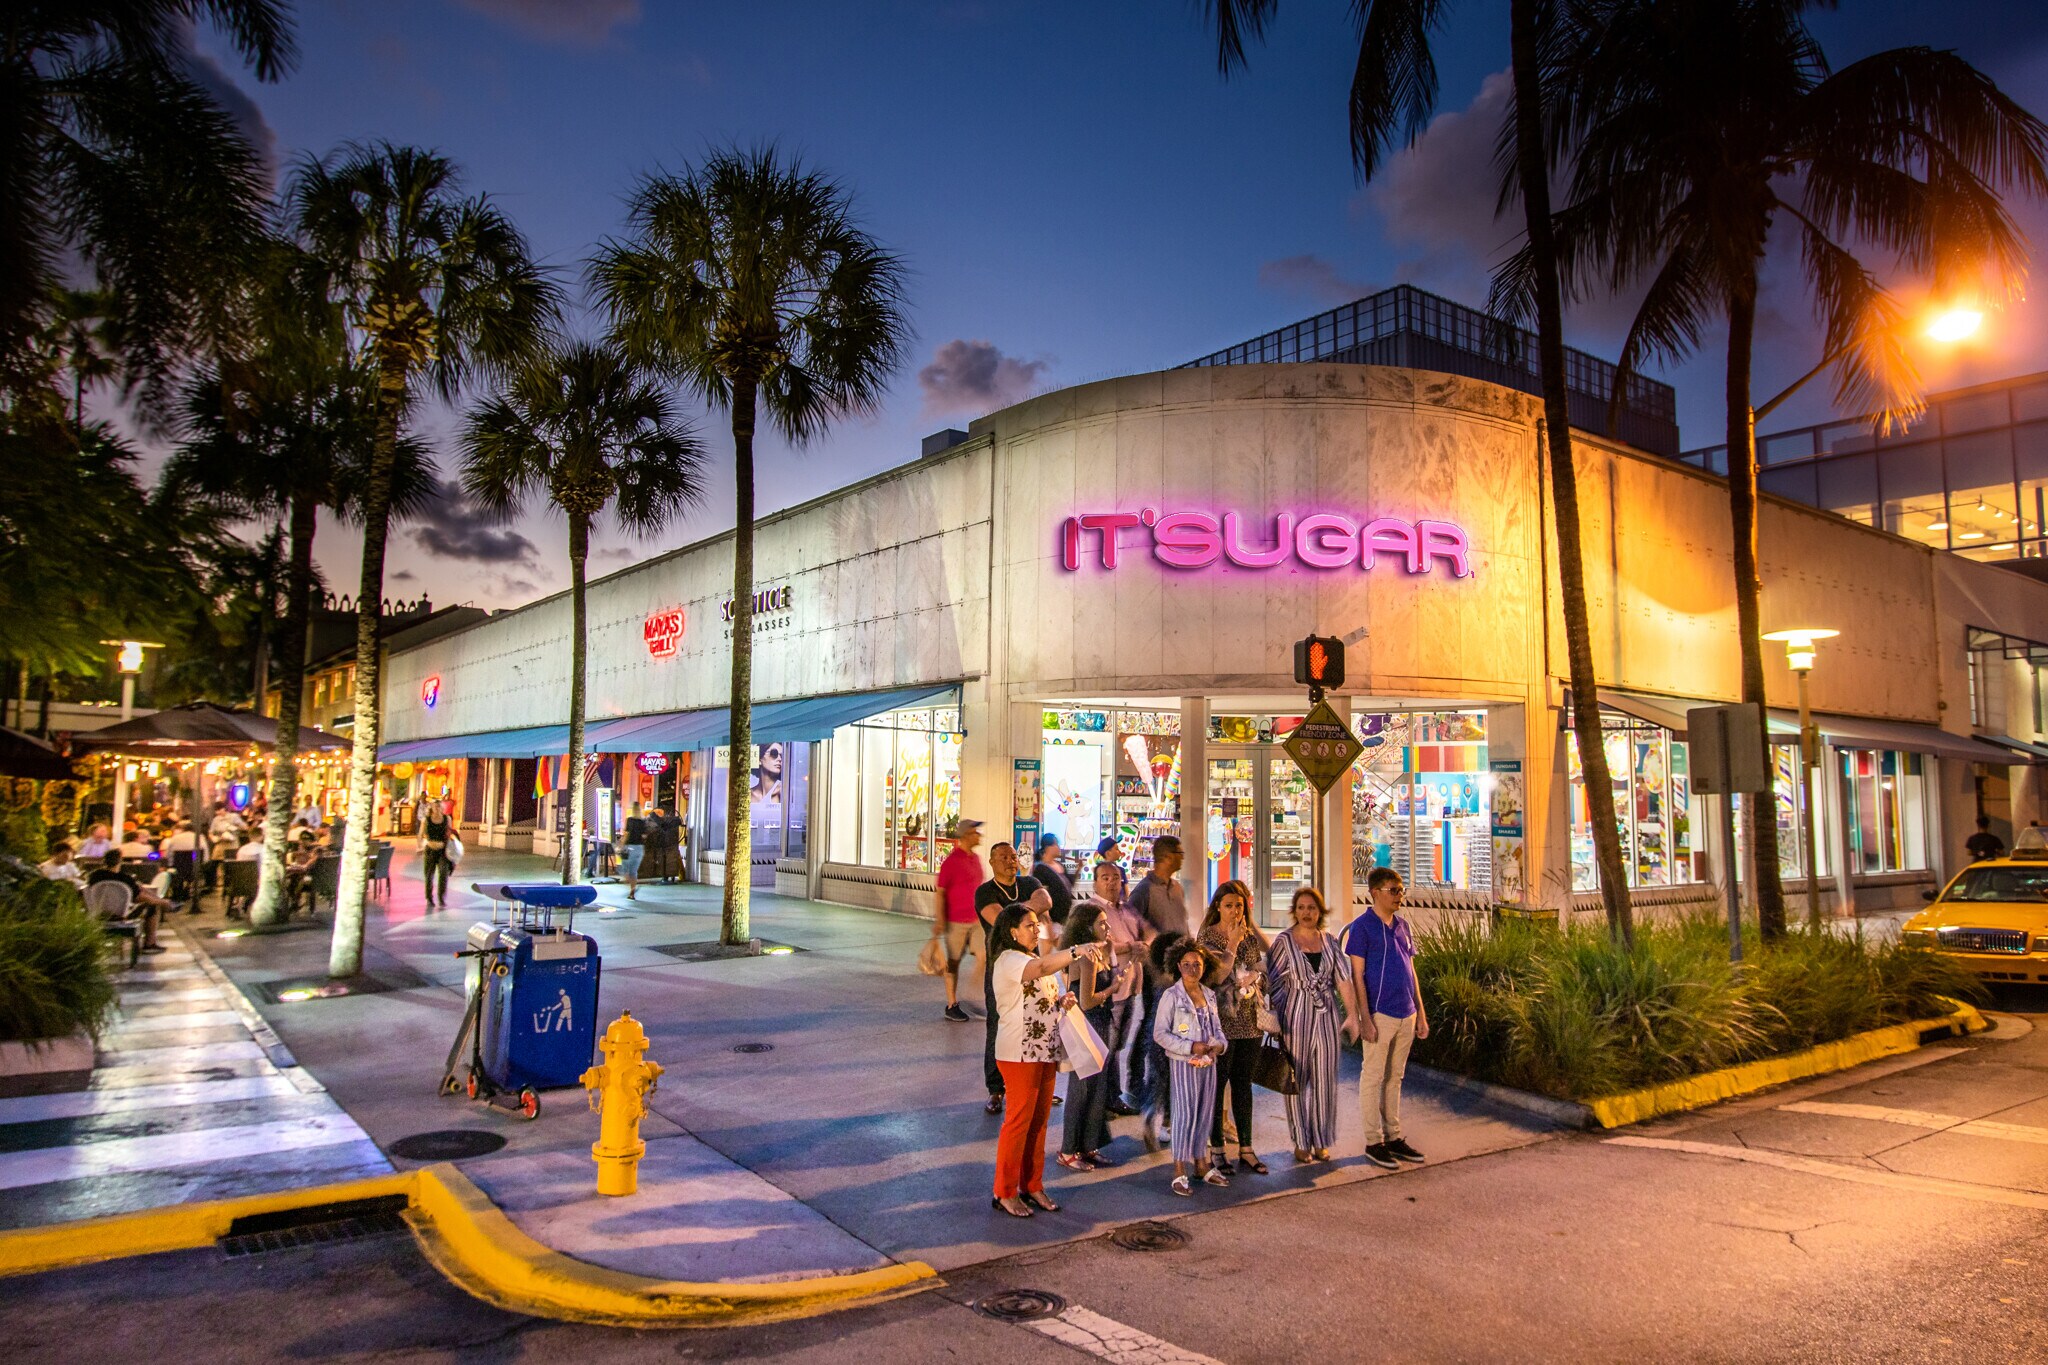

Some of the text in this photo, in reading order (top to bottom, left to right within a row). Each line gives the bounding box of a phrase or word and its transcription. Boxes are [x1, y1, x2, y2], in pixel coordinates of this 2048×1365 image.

[1063, 508, 1469, 578] IT'SUGAR
[720, 585, 791, 621] SOTICE
[724, 616, 791, 639] SULASSES
[1300, 730, 1327, 738] FRIENDLY
[1305, 724, 1341, 732] PEDESTRIAN
[904, 773, 949, 817] Sprng
